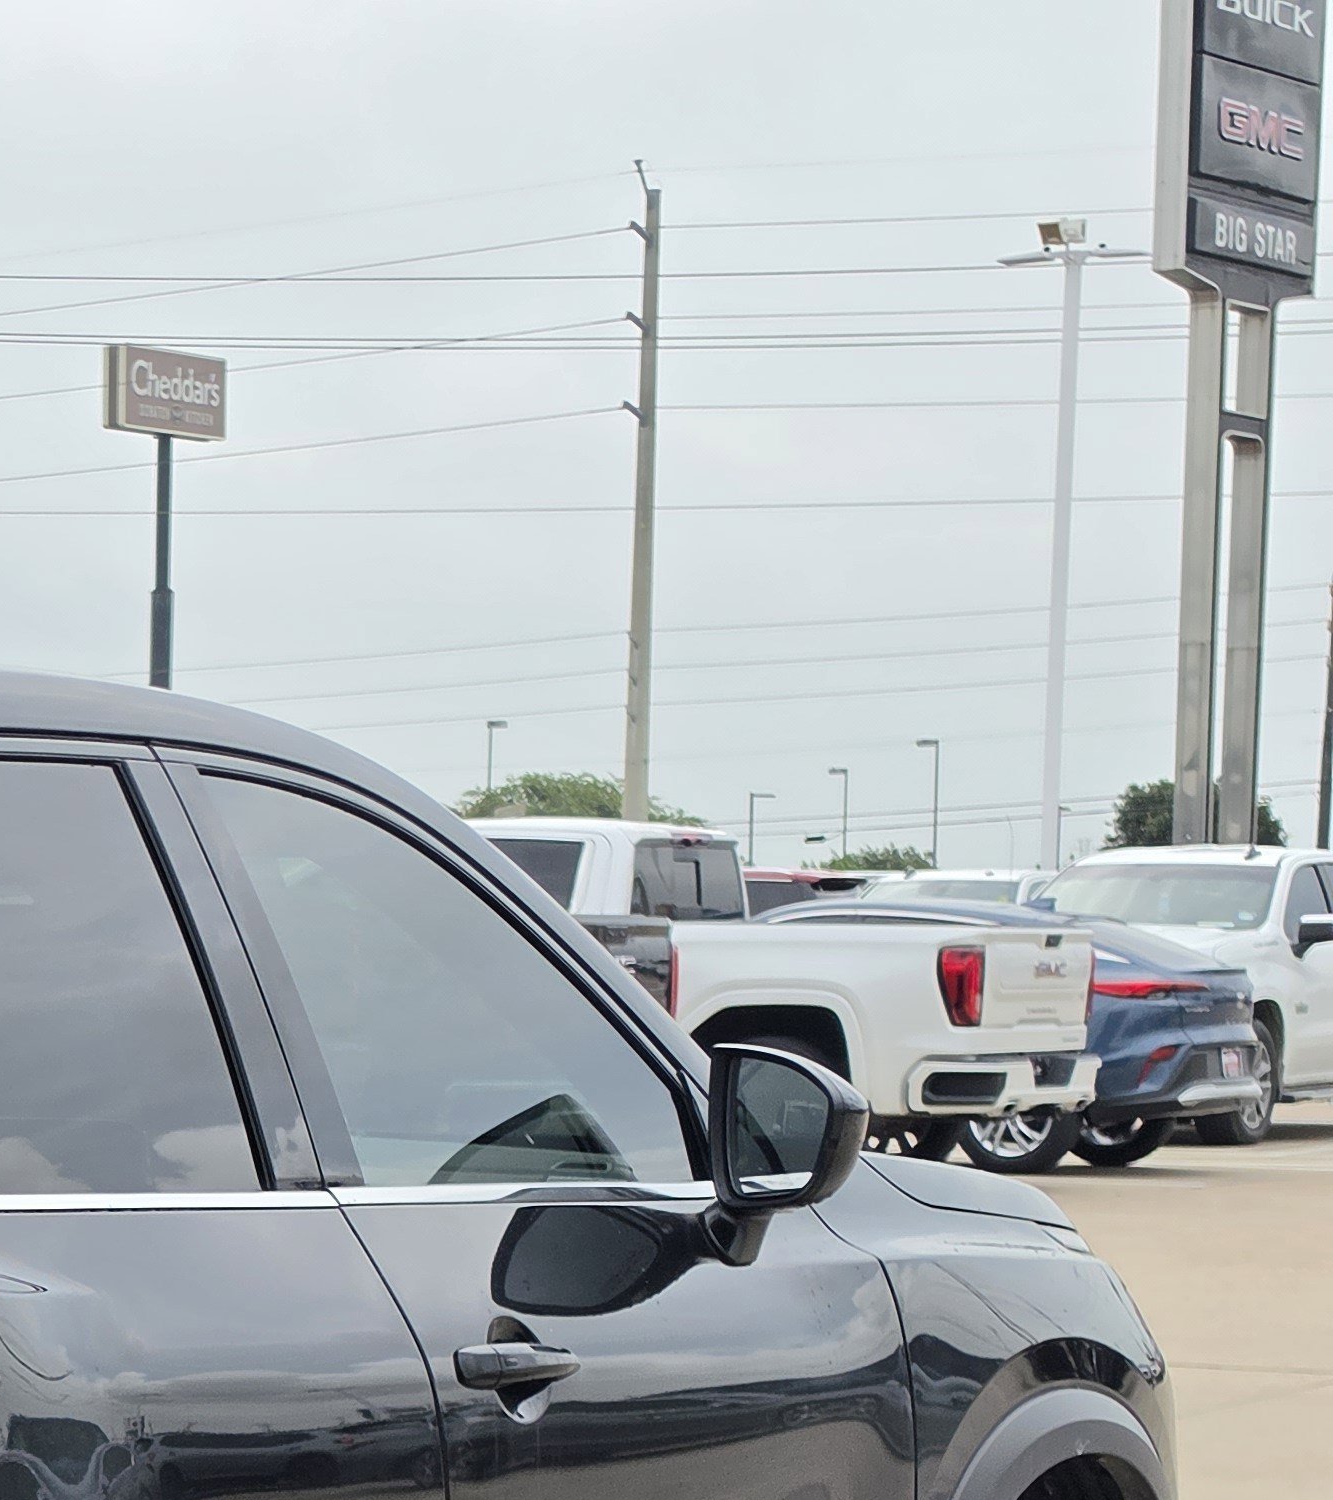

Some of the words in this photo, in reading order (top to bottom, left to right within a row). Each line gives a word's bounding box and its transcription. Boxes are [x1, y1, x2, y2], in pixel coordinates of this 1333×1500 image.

[1218, 97, 1304, 160] GMC
[1214, 211, 1247, 252] BIG
[1253, 221, 1297, 265] STAR
[131, 359, 221, 407] Cheddar's
